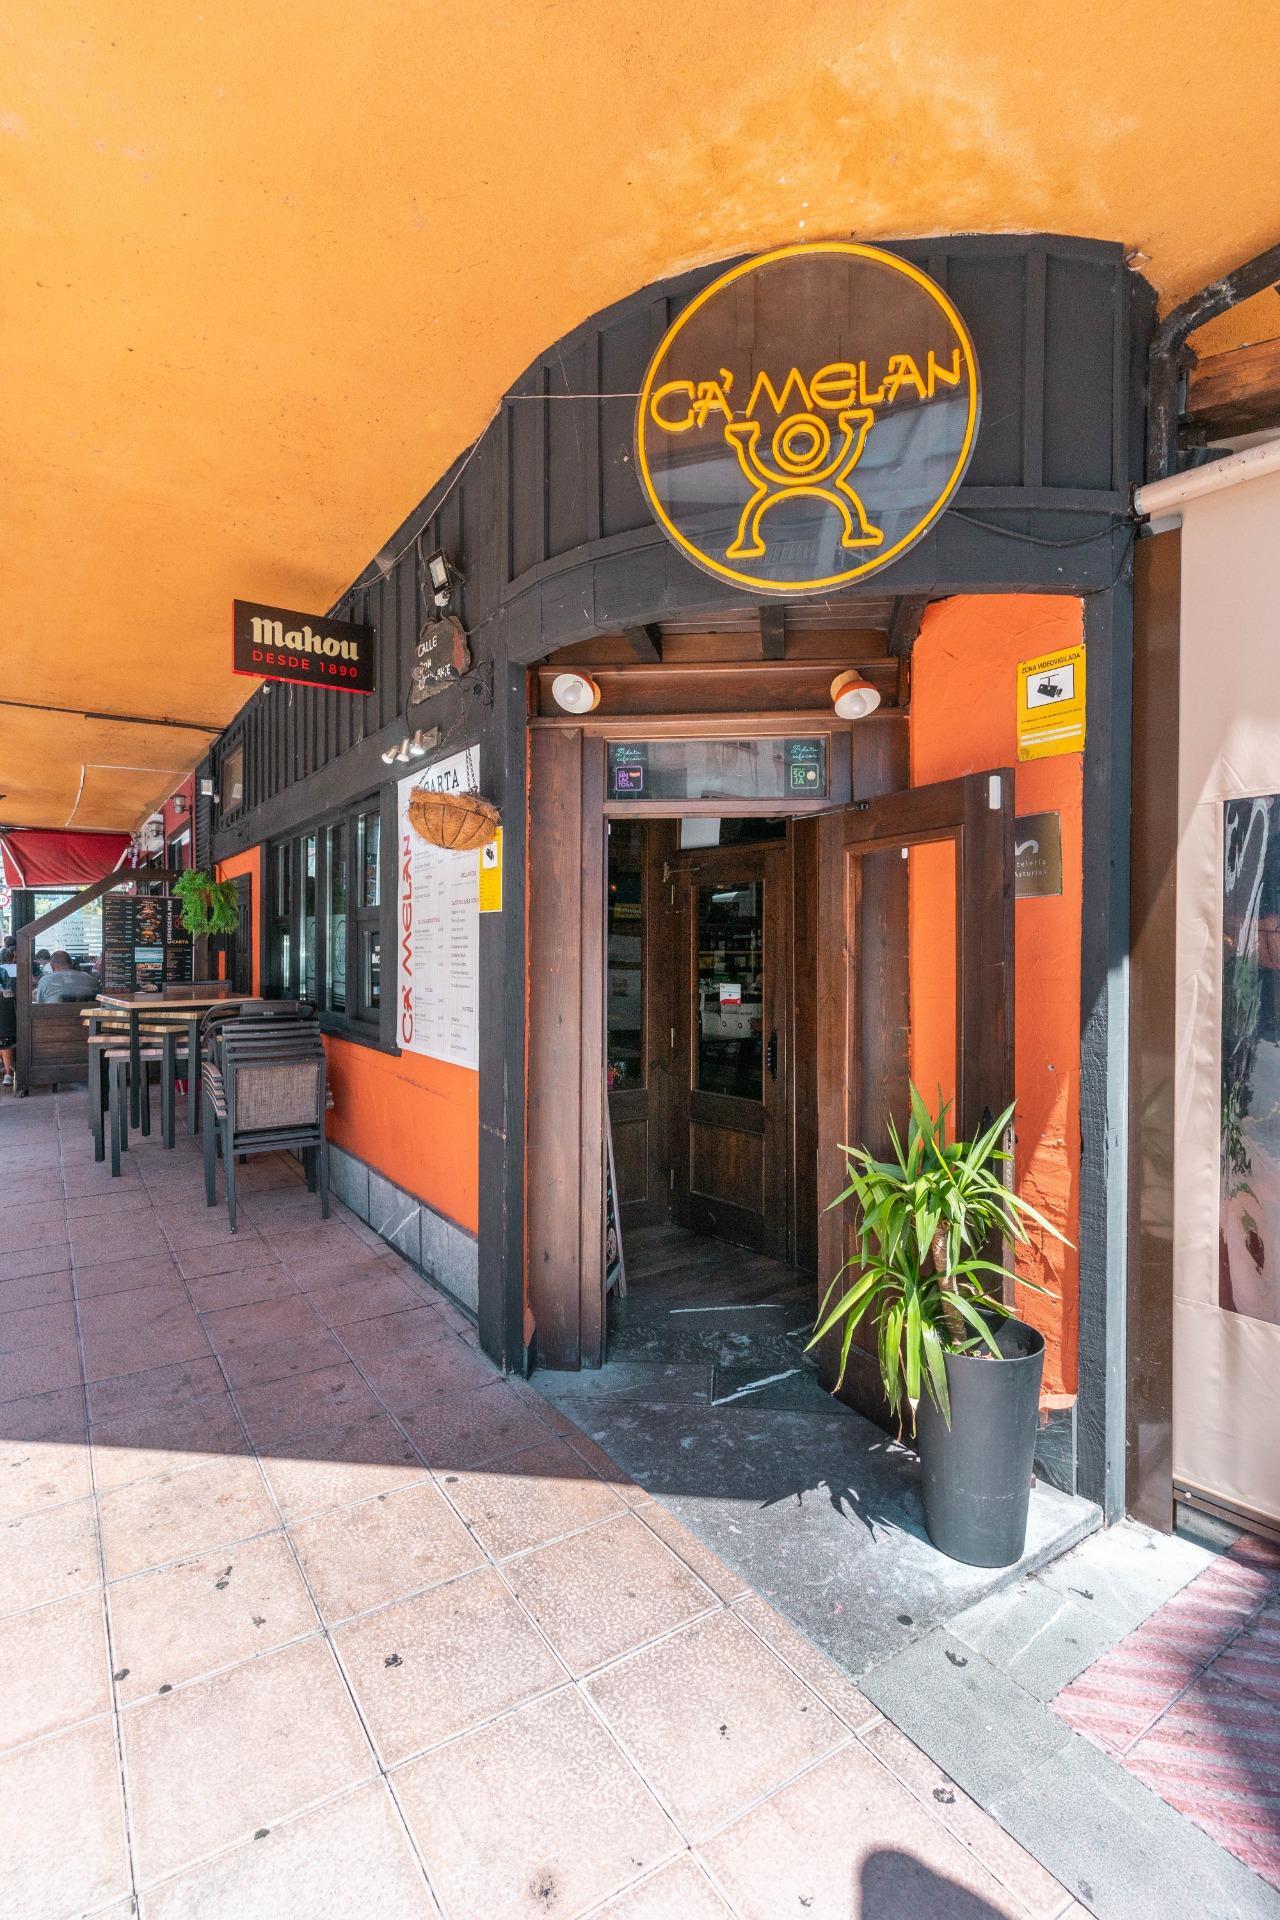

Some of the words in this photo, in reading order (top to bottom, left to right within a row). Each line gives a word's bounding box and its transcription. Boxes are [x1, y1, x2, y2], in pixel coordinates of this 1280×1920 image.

[250, 616, 360, 661] Mahou
[417, 635, 438, 657] CALLE
[252, 650, 311, 670] DESDE
[319, 661, 358, 678] 1890
[1021, 664, 1037, 674] ZONA
[1037, 652, 1081, 670] VIDEOVIGILADA
[424, 768, 460, 792] CARTA
